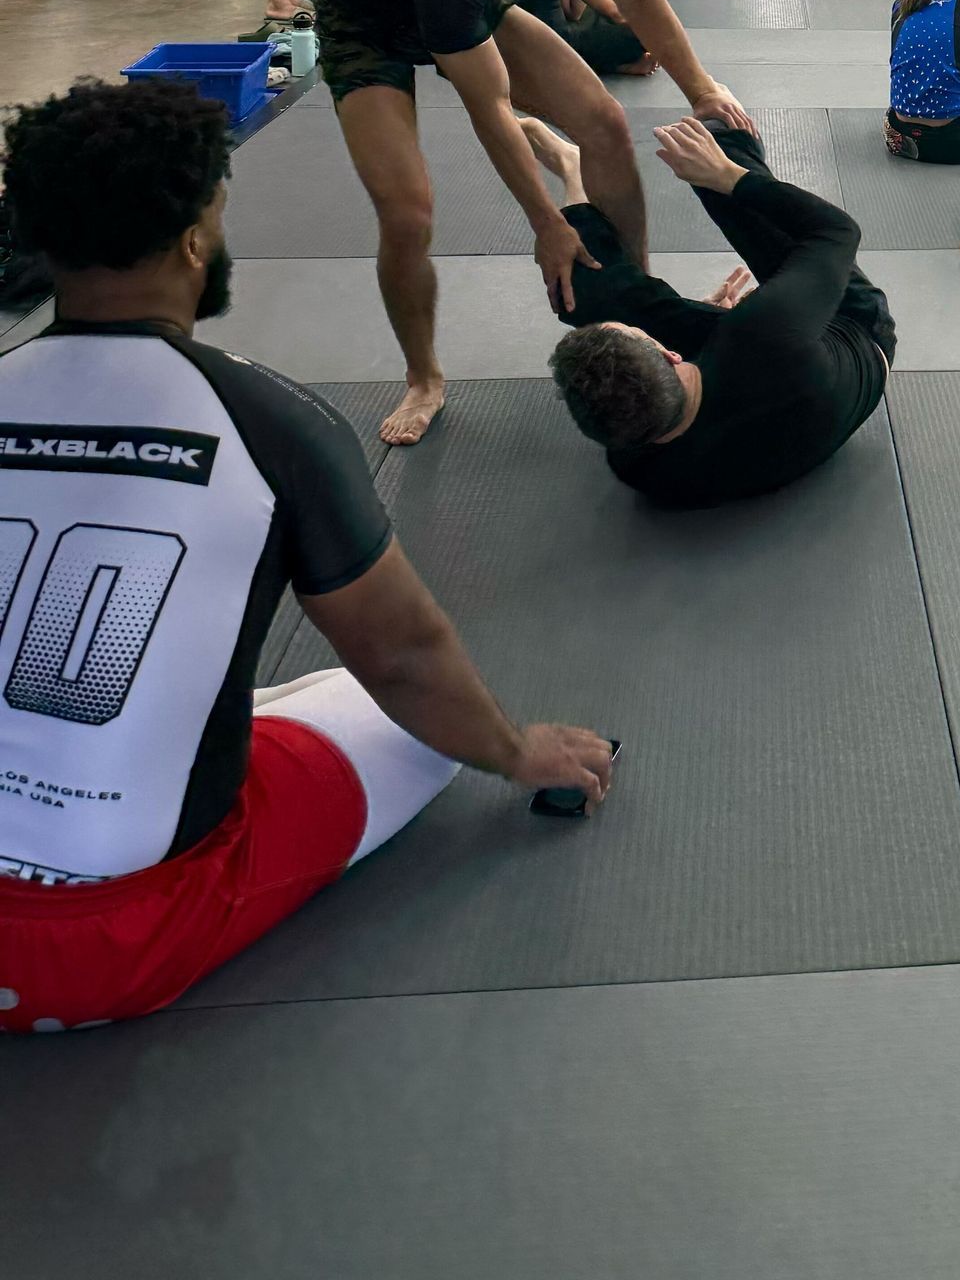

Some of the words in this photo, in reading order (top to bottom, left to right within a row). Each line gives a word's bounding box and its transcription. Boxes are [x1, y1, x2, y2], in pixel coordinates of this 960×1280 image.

[0, 437, 203, 468] LXBLACK
[30, 792, 65, 809] USA
[35, 780, 122, 801] ANGELES
